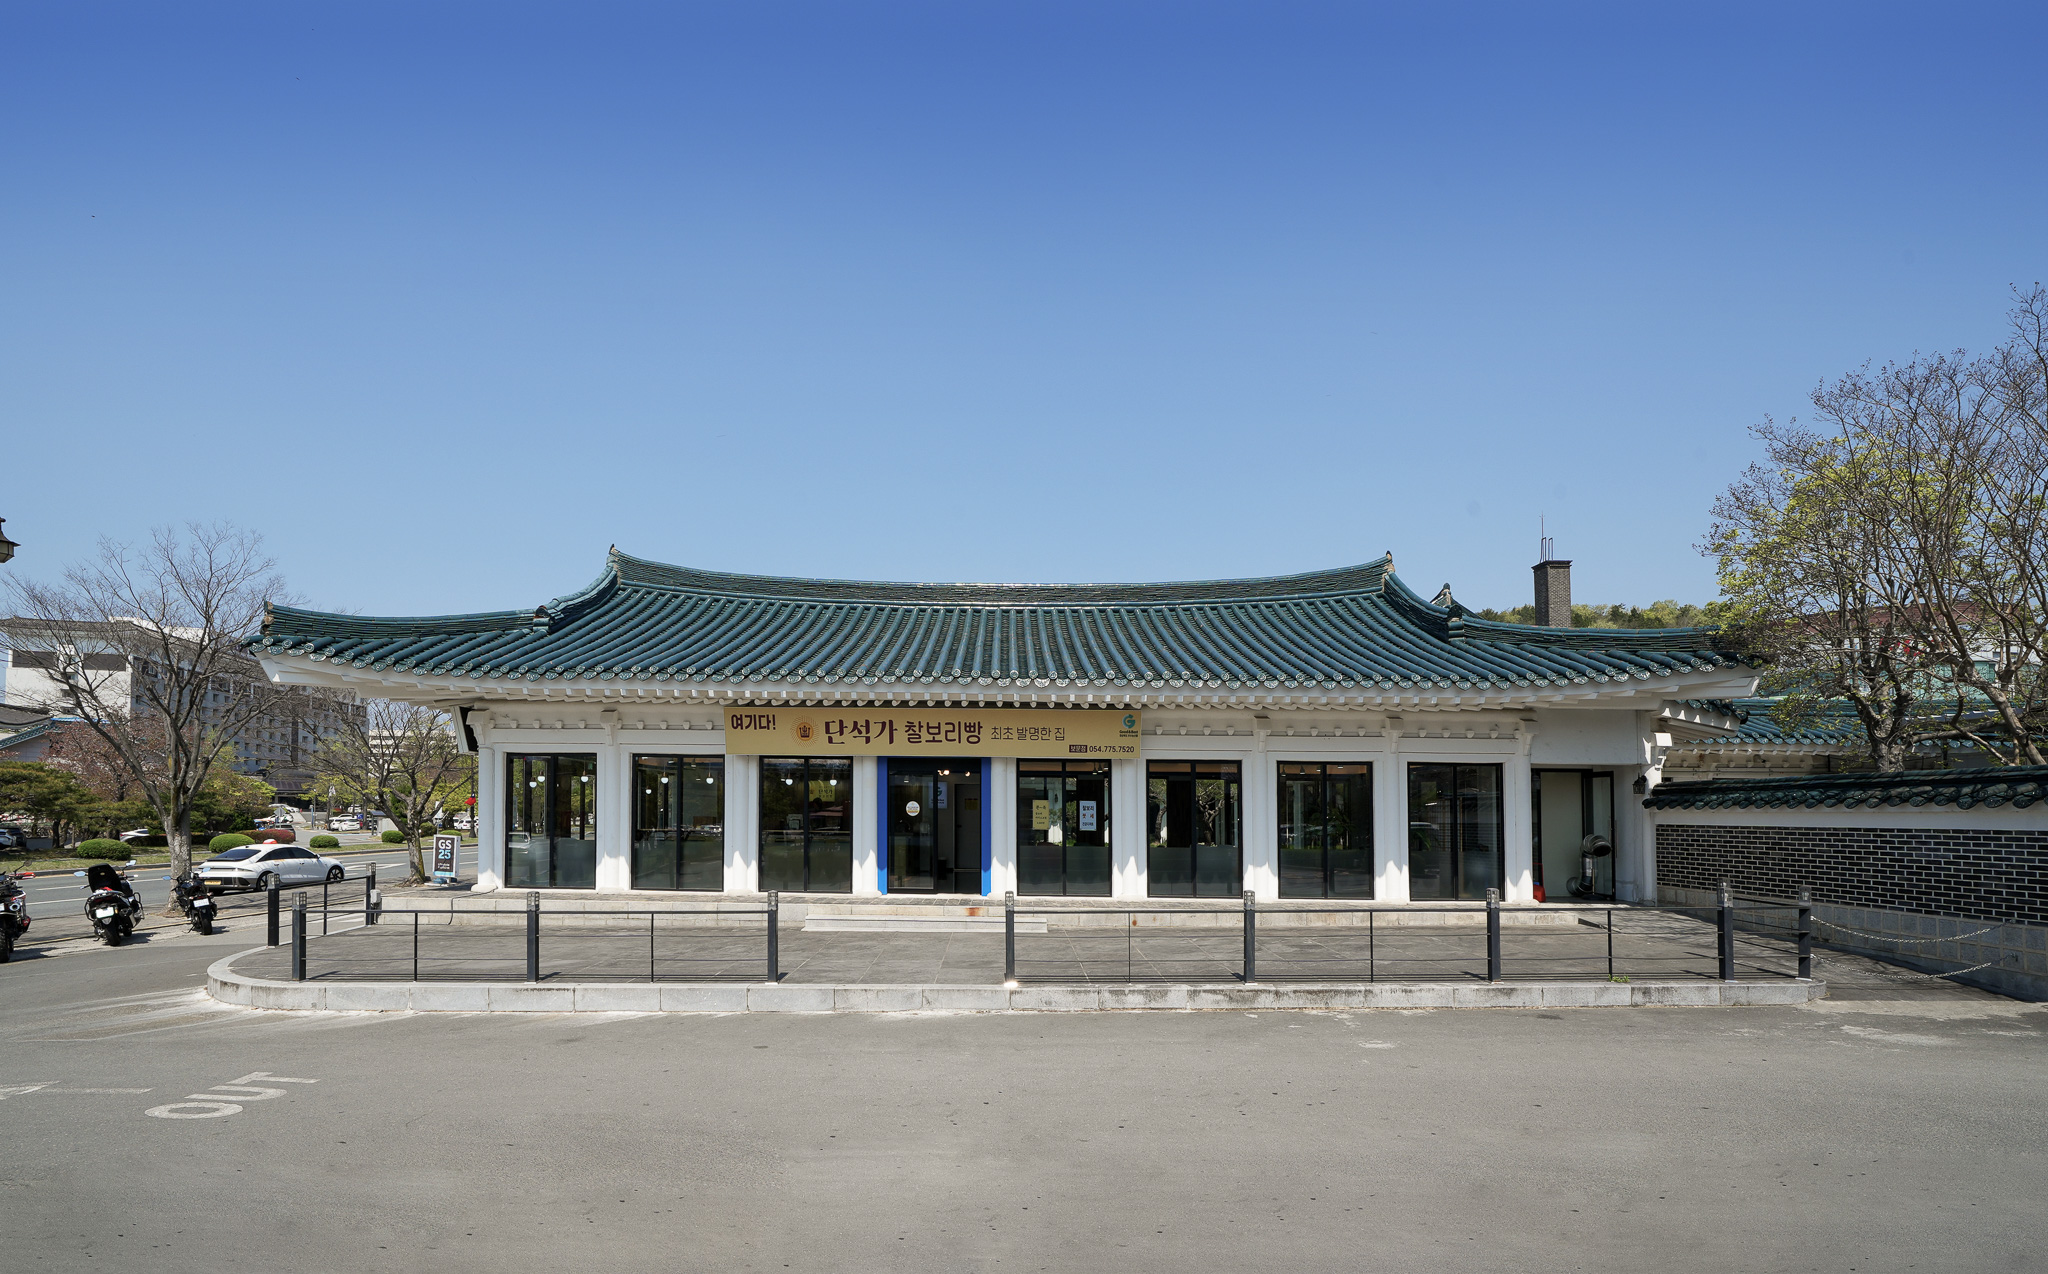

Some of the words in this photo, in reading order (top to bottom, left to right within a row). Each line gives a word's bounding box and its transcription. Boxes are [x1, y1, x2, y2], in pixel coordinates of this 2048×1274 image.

[731, 714, 776, 730] 여기다!
[824, 719, 898, 745] 단석가
[904, 720, 983, 745] 찰보리빵
[991, 726, 1014, 741] 최초
[1016, 726, 1052, 741] 발명한
[1054, 727, 1065, 741] 집
[1089, 745, 1135, 753] 054.775.7520
[438, 839, 452, 850] GS
[438, 849, 451, 860] 25
[144, 1071, 321, 1119] OUT
